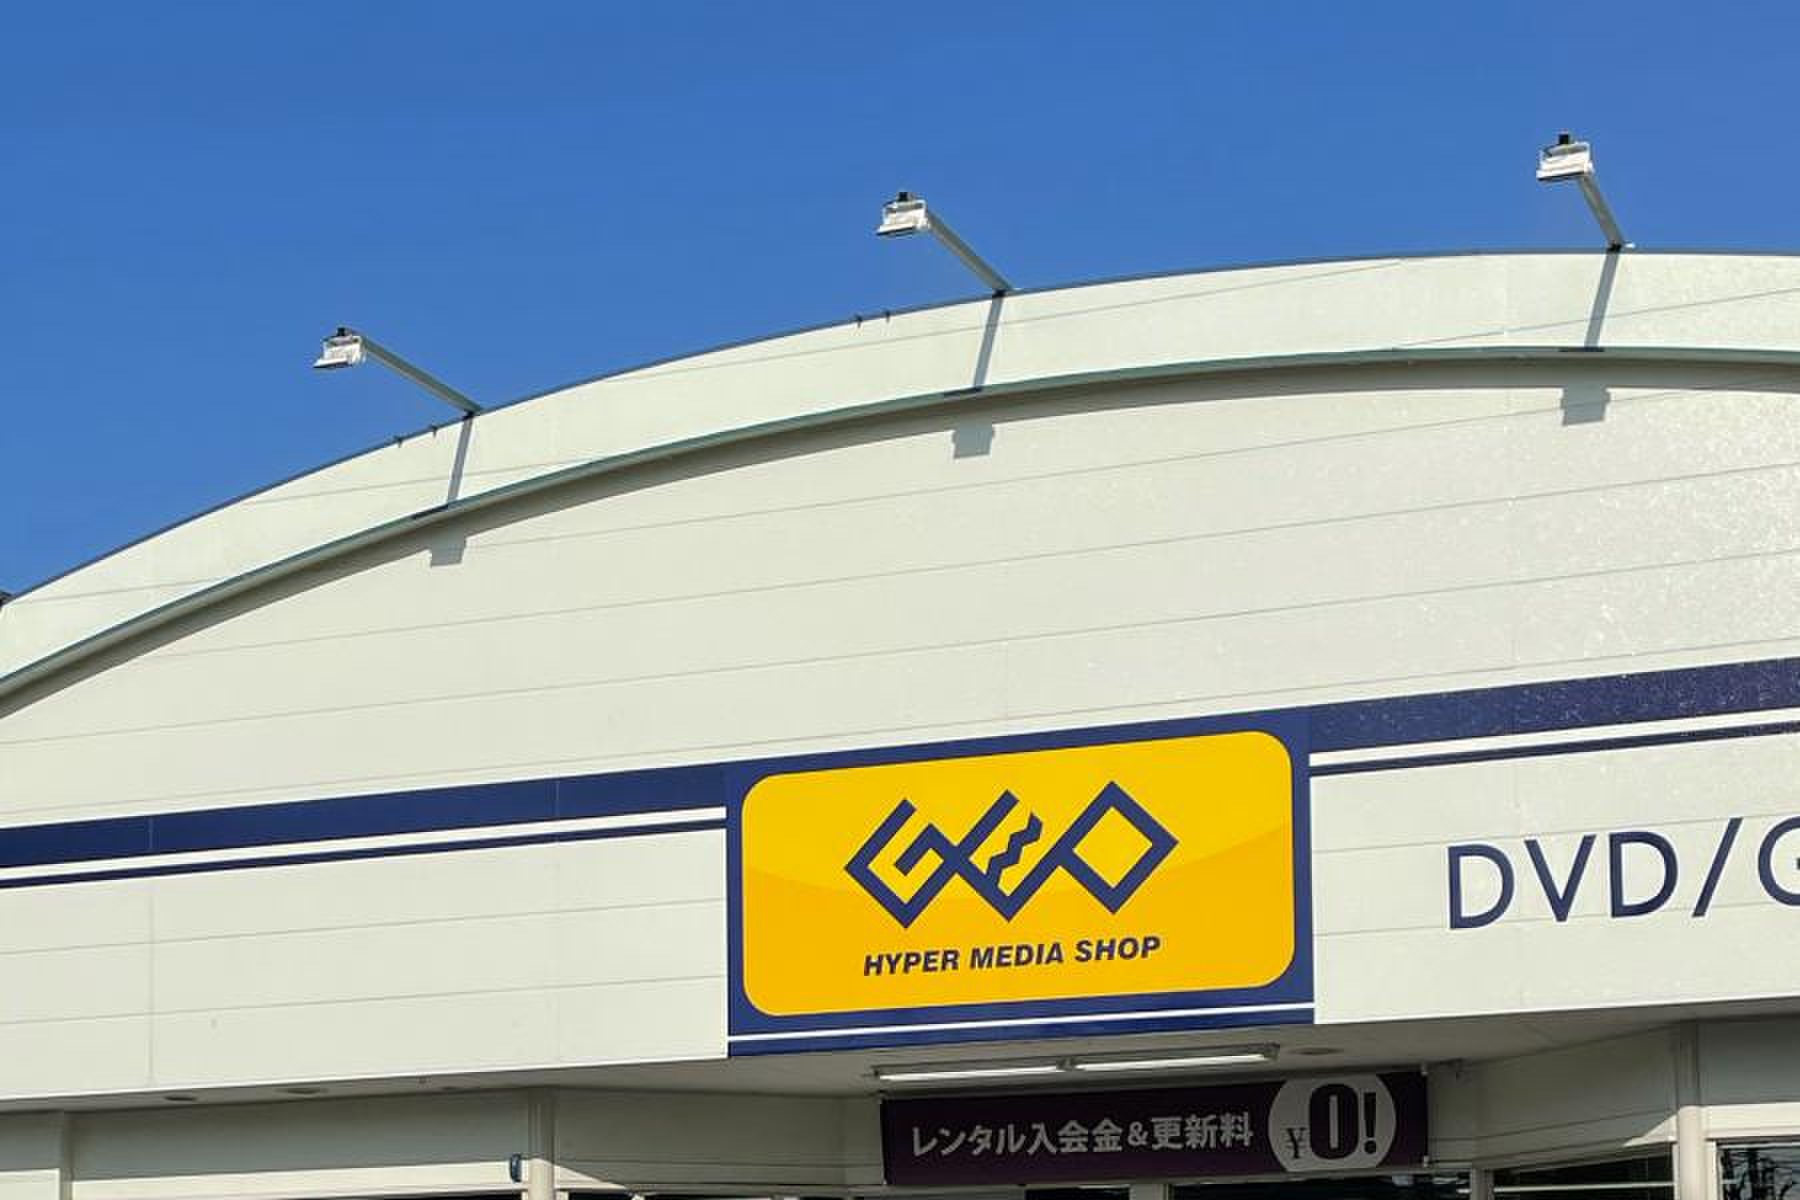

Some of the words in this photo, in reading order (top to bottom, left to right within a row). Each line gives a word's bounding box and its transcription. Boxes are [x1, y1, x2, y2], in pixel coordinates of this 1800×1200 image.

[863, 948, 960, 977] HYPER
[969, 941, 1064, 970] MEDIA
[1075, 935, 1162, 963] SHOP
[911, 1111, 1255, 1159] レンタル入会金&更新料
